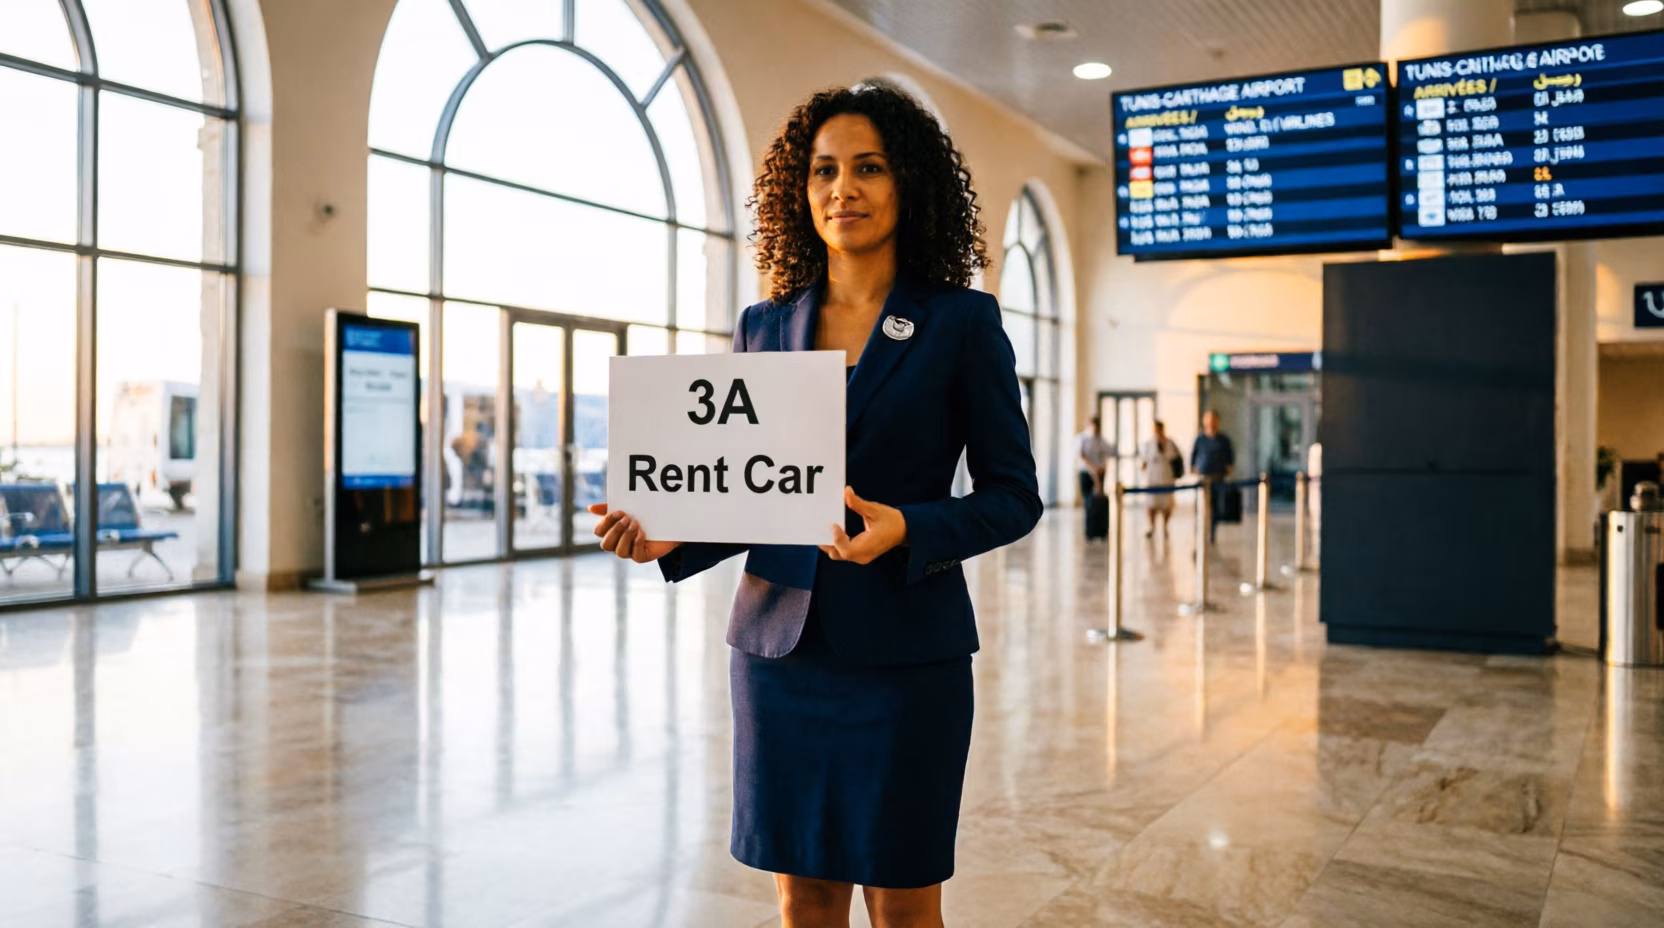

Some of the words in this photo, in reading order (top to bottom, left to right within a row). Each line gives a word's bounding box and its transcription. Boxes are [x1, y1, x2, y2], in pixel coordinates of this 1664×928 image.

[1241, 77, 1305, 99] AIRPORT
[687, 378, 759, 425] 3A
[628, 454, 729, 493] Rent
[743, 454, 824, 494] Car
